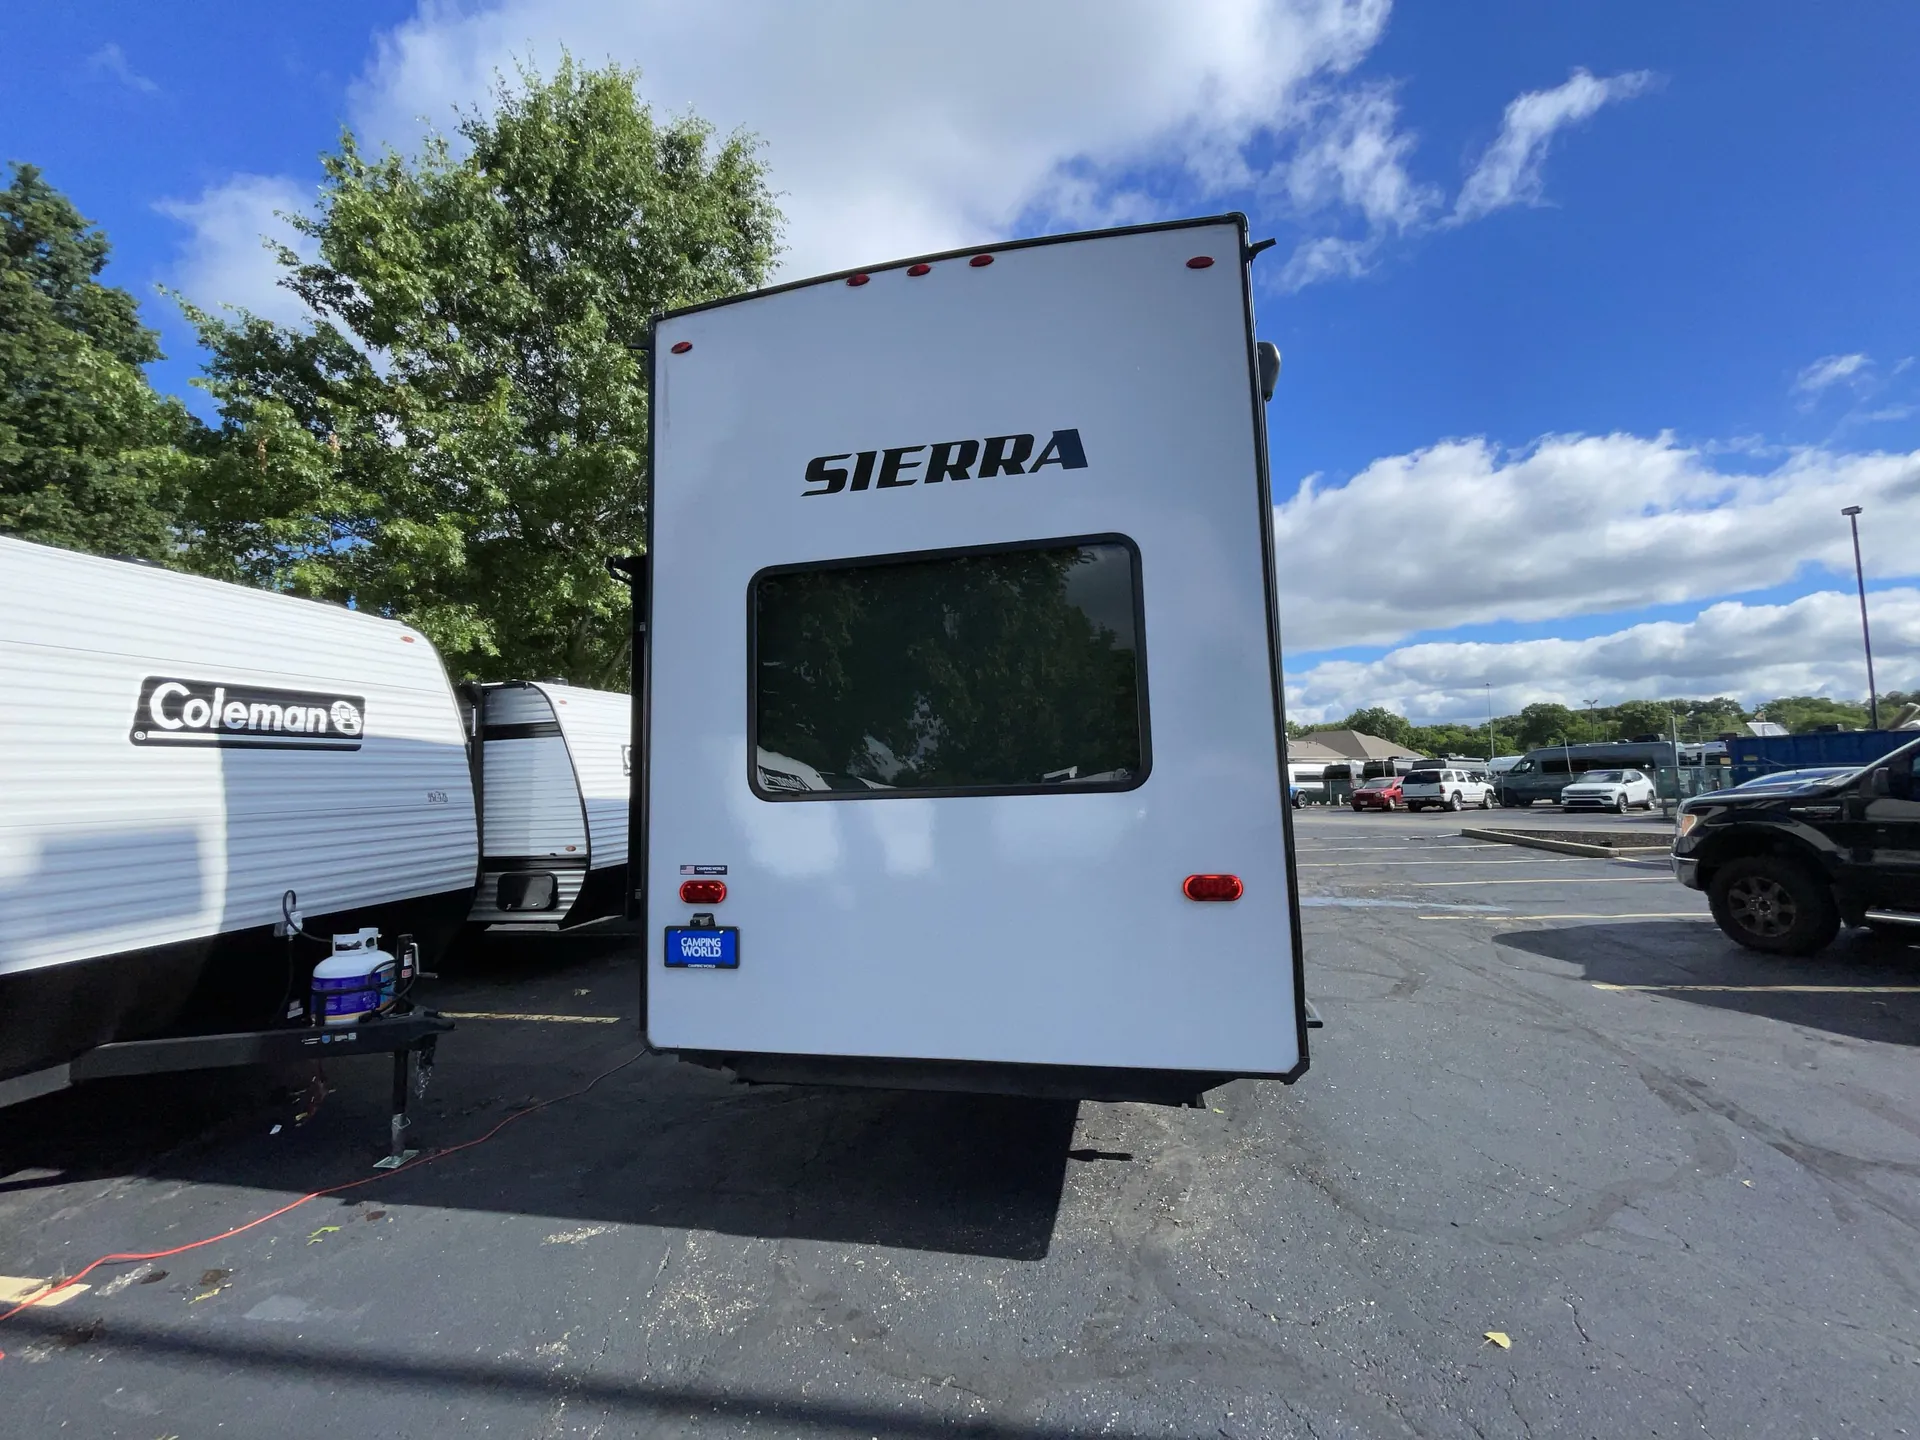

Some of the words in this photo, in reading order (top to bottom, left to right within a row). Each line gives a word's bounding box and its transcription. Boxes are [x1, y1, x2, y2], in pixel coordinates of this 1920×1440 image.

[800, 428, 1089, 497] SIERRA
[149, 681, 328, 733] Coleman
[680, 937, 722, 947] CAMPING
[681, 946, 722, 958] WORLD
